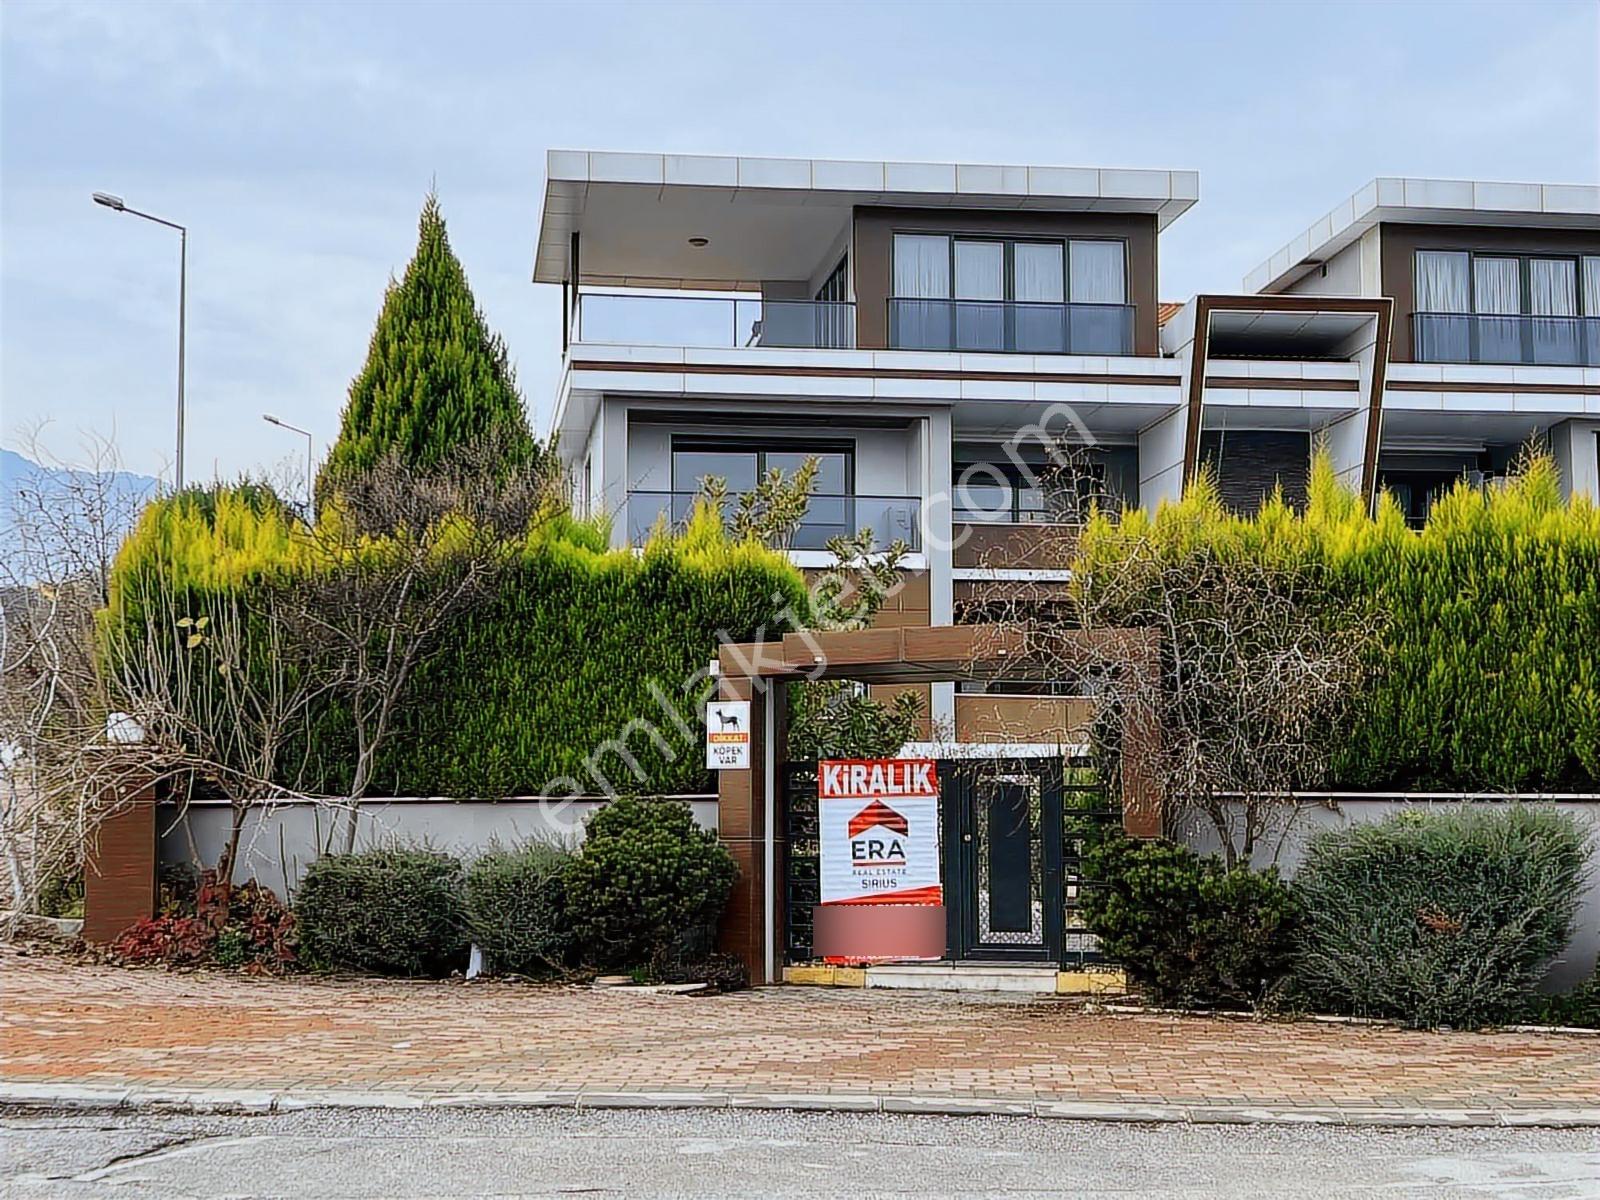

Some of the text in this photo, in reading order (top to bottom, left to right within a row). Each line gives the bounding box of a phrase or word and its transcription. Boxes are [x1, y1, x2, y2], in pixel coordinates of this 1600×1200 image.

[852, 839, 906, 860] ERA
[852, 868, 873, 876] REAL
[861, 879, 897, 889] SIRIUS
